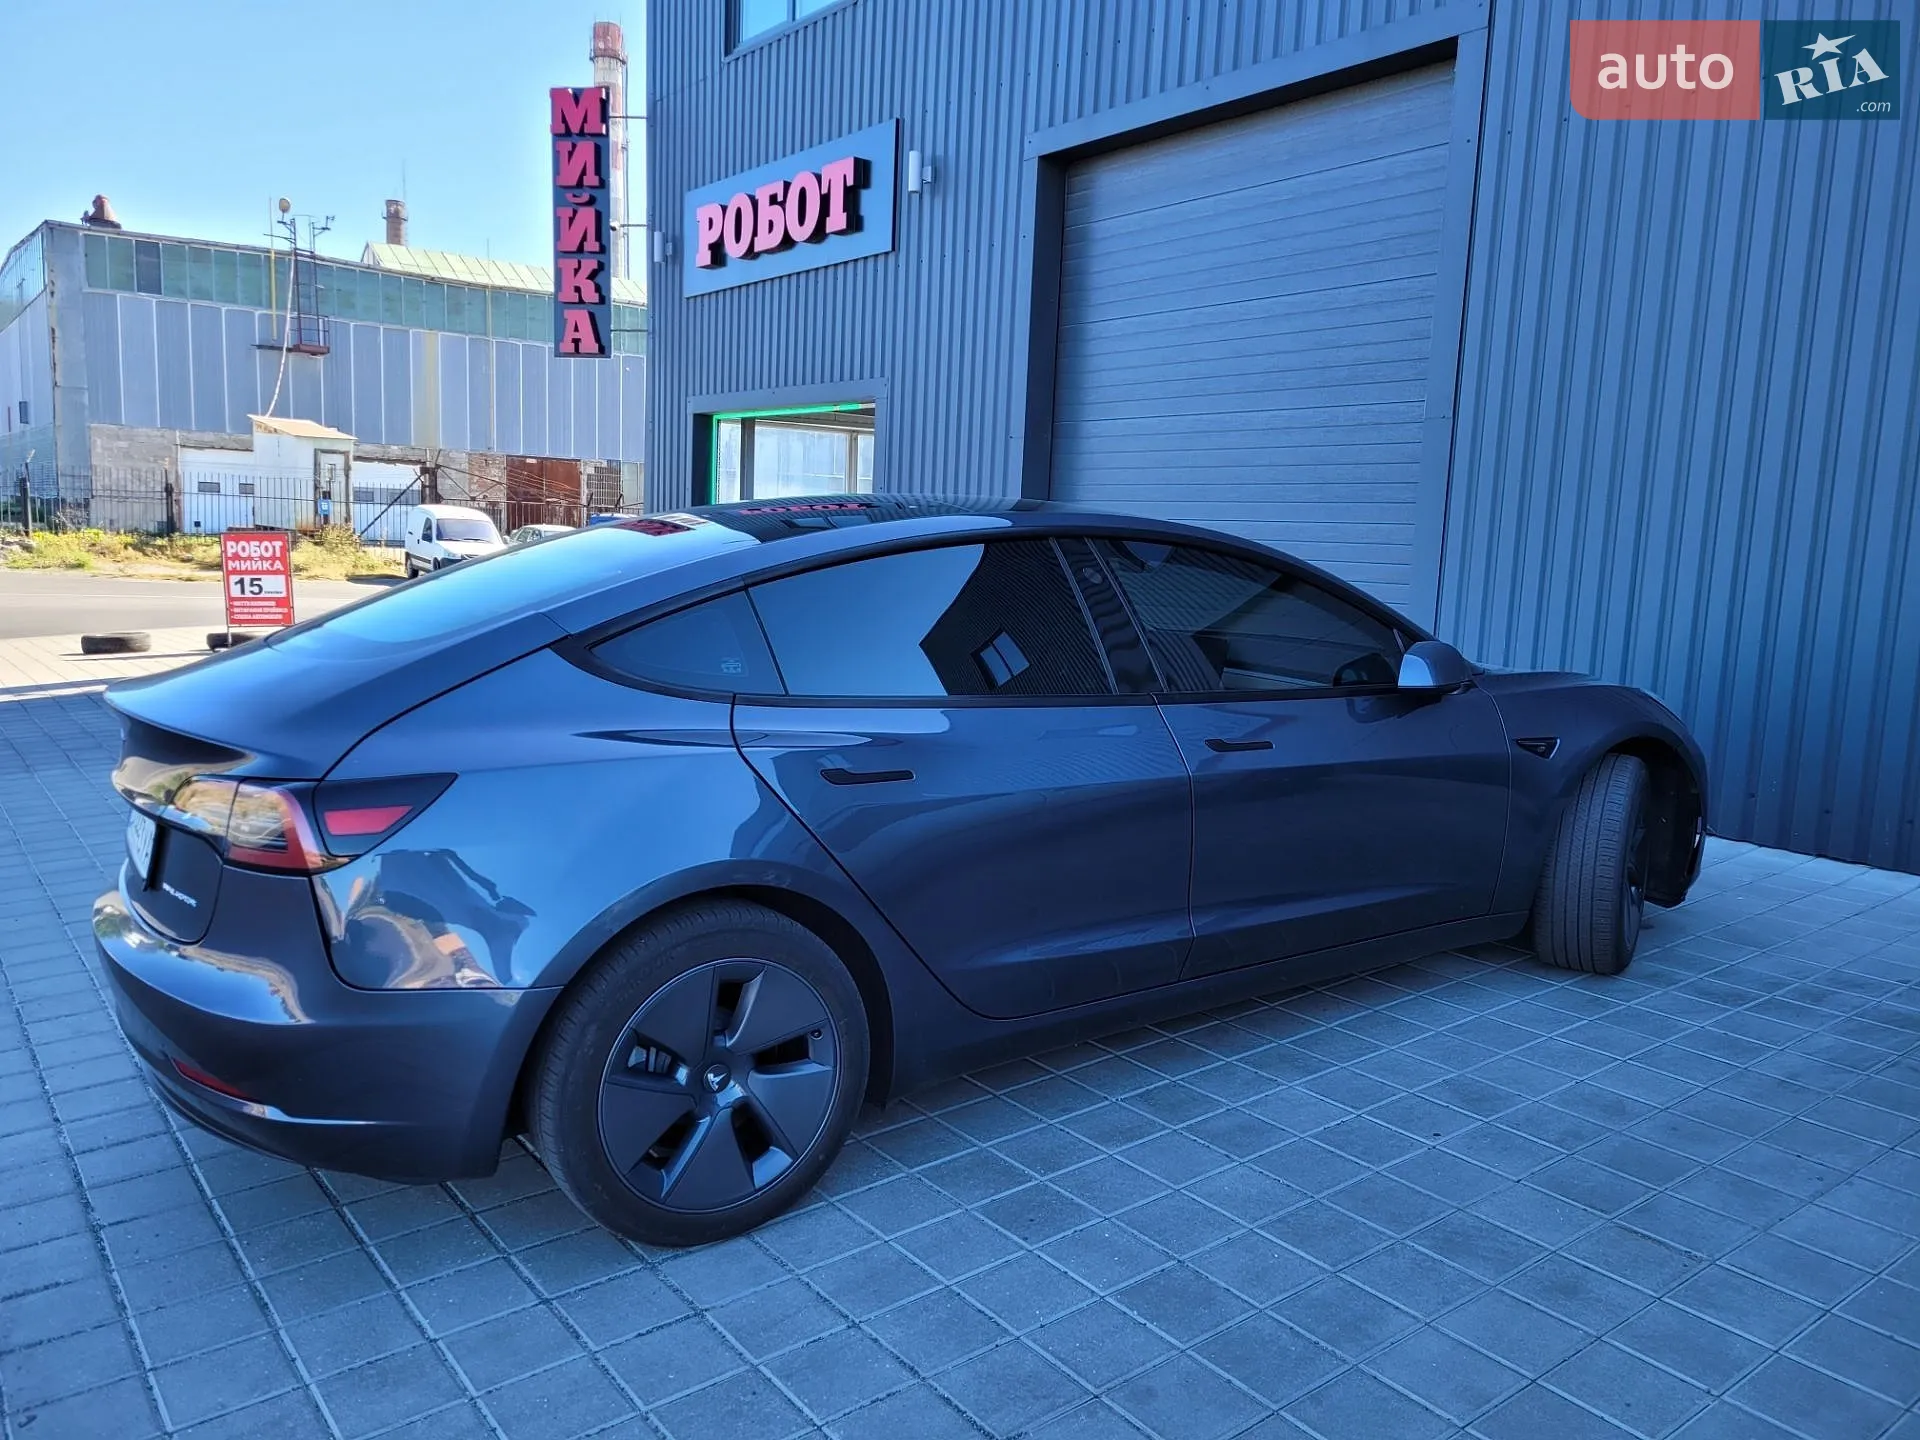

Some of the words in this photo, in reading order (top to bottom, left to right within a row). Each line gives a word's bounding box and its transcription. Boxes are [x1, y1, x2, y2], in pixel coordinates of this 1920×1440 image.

[550, 87, 606, 354] МИЙКА
[696, 156, 857, 268] РОБОТ
[226, 541, 283, 558] РОБОТ
[228, 558, 284, 571] МИЙКА
[234, 577, 264, 596] 15
